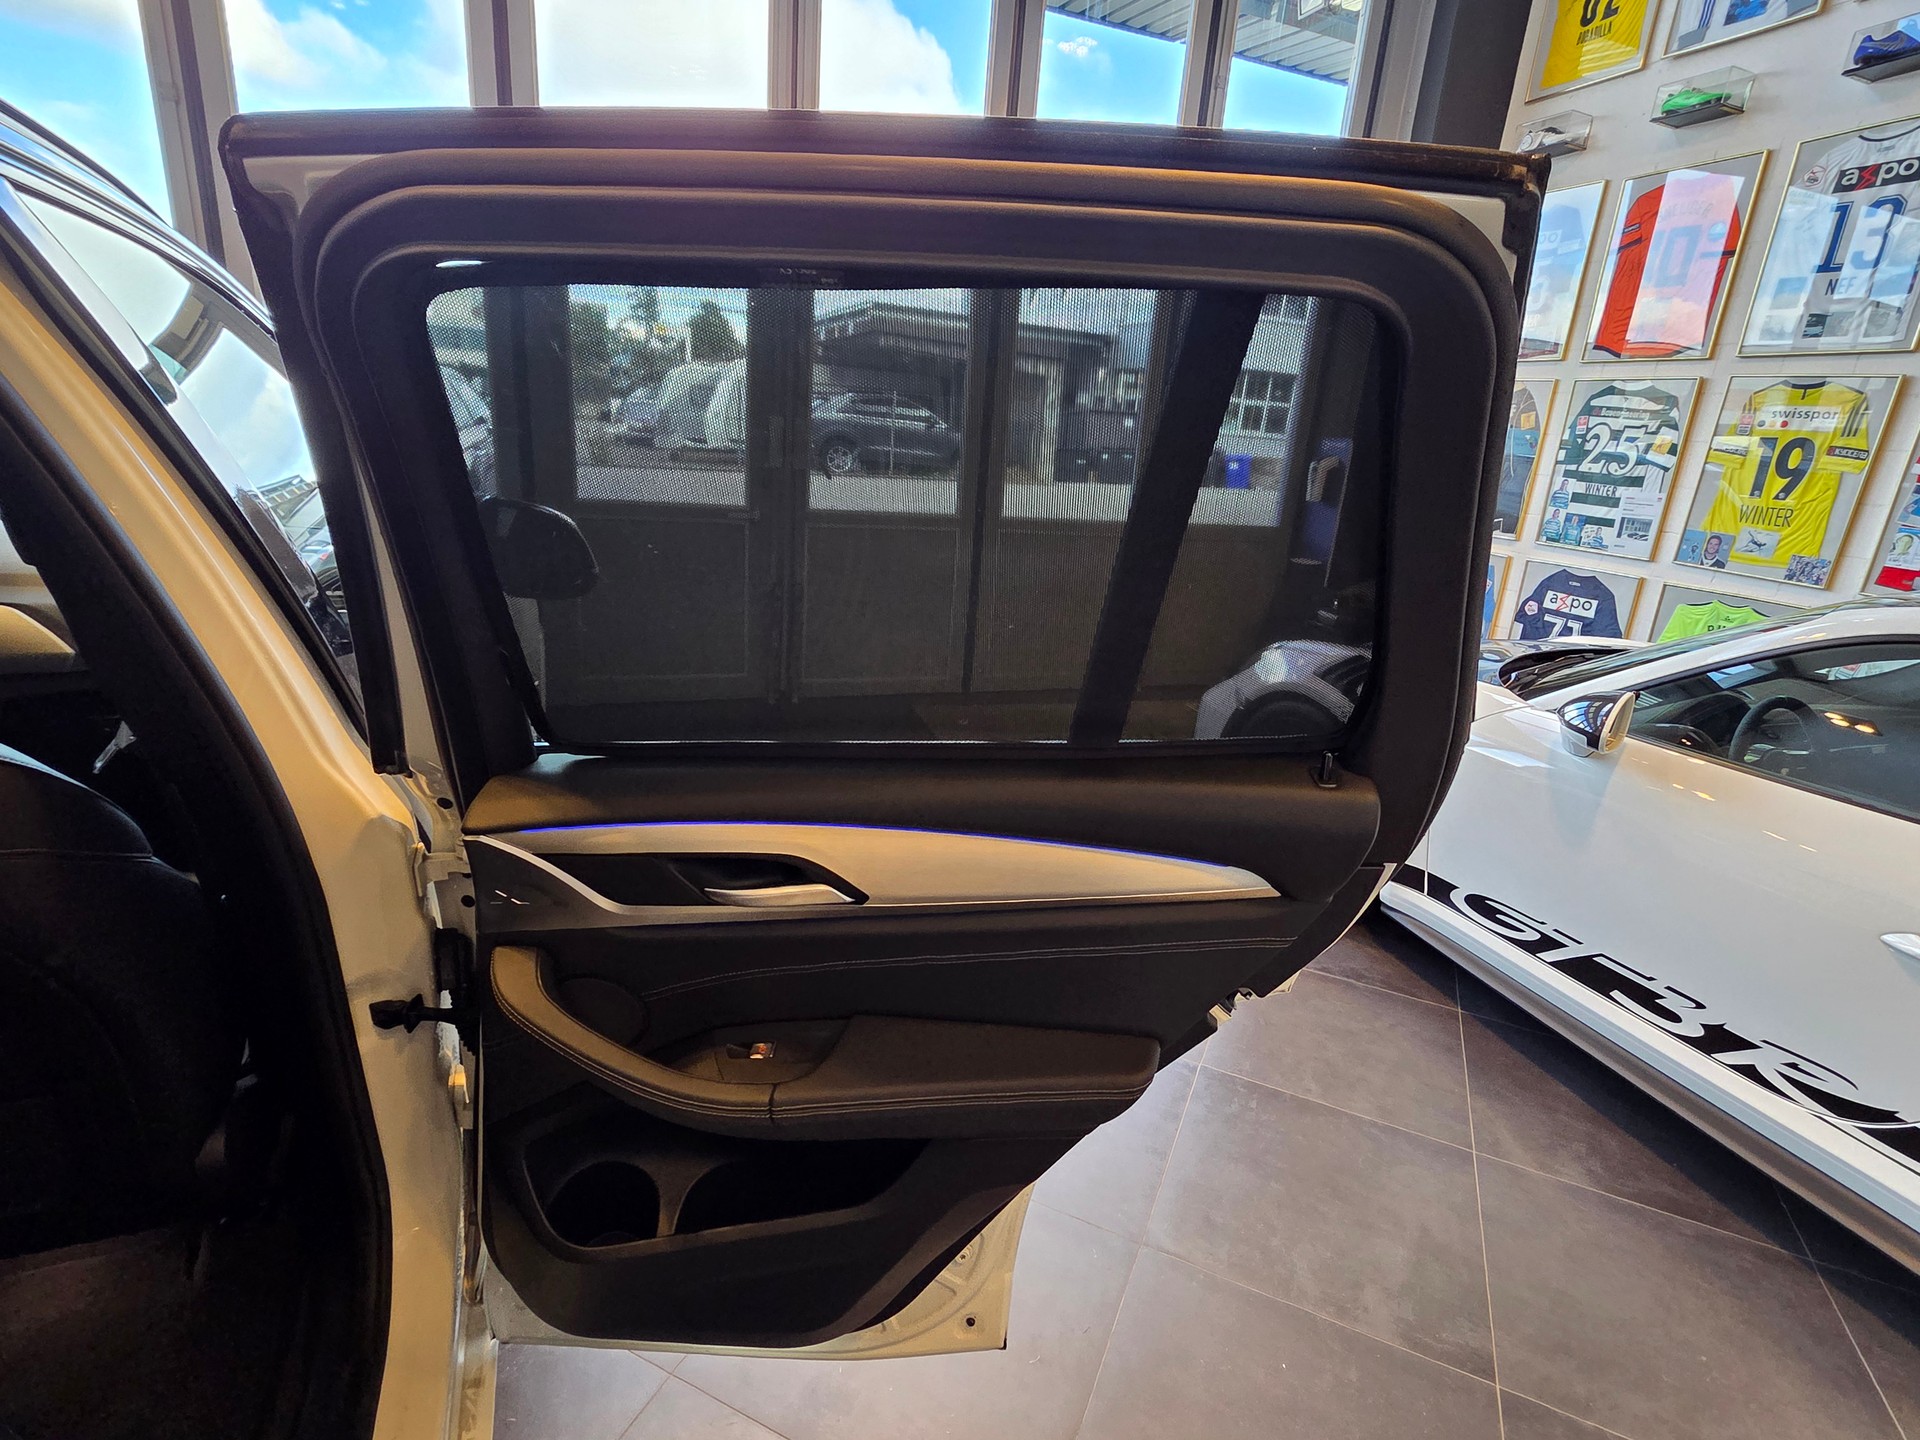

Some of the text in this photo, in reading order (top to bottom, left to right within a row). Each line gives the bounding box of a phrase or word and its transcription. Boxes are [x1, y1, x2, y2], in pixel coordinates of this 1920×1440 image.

[1578, 422, 1647, 476] 25
[1749, 437, 1816, 501] 19
[1585, 483, 1618, 497] WINTER
[1739, 504, 1794, 528] WINTER
